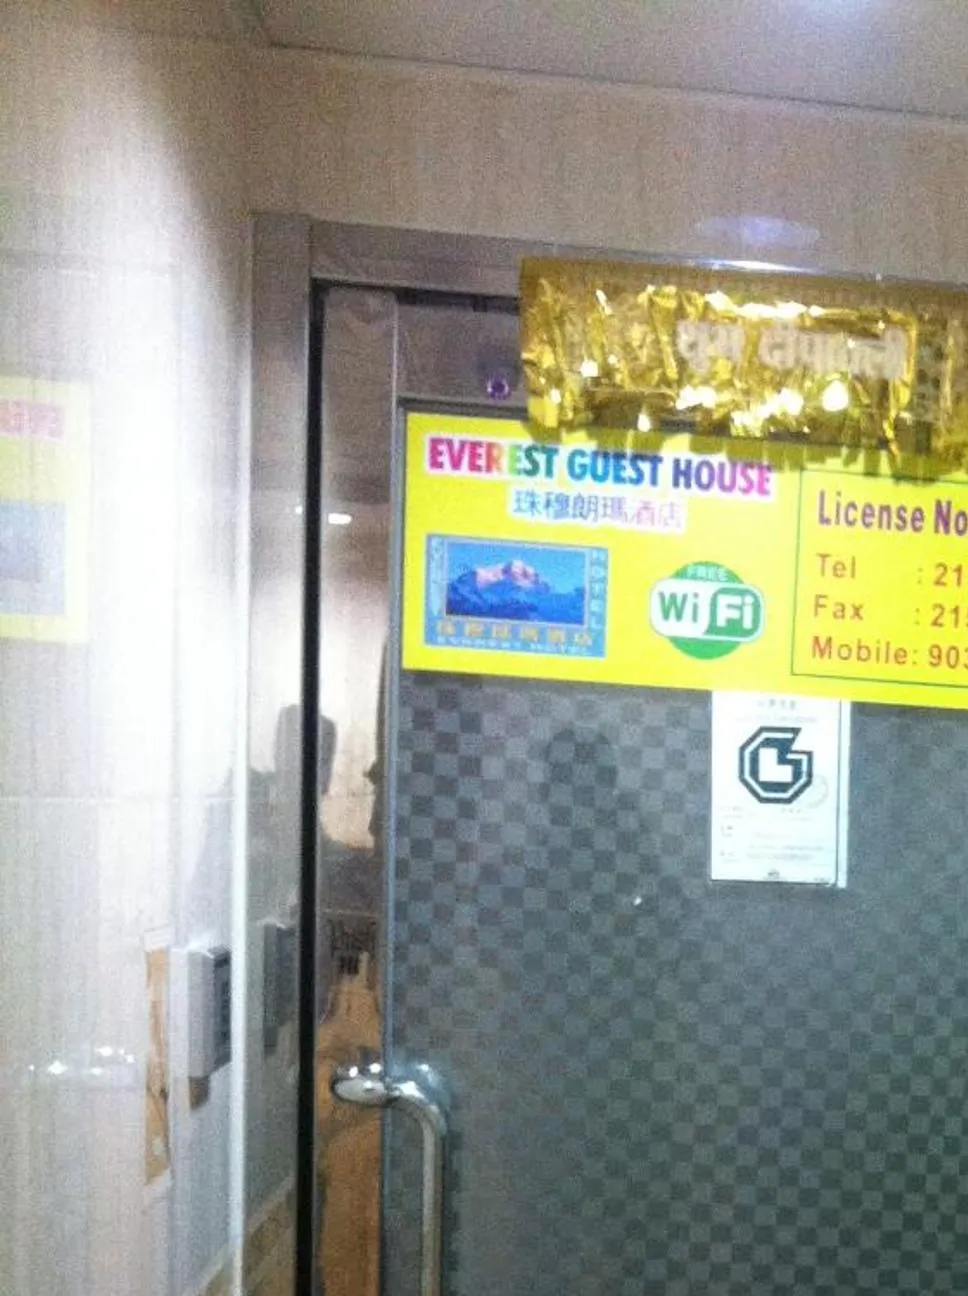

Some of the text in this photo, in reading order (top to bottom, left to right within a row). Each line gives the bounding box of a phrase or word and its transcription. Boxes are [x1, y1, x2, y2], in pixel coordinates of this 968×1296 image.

[427, 436, 772, 496] EVEREST GUEST HOUSE
[817, 488, 926, 534] License
[815, 552, 857, 581] Tel
[813, 593, 865, 622] Fax
[811, 635, 918, 666] Mobile:
